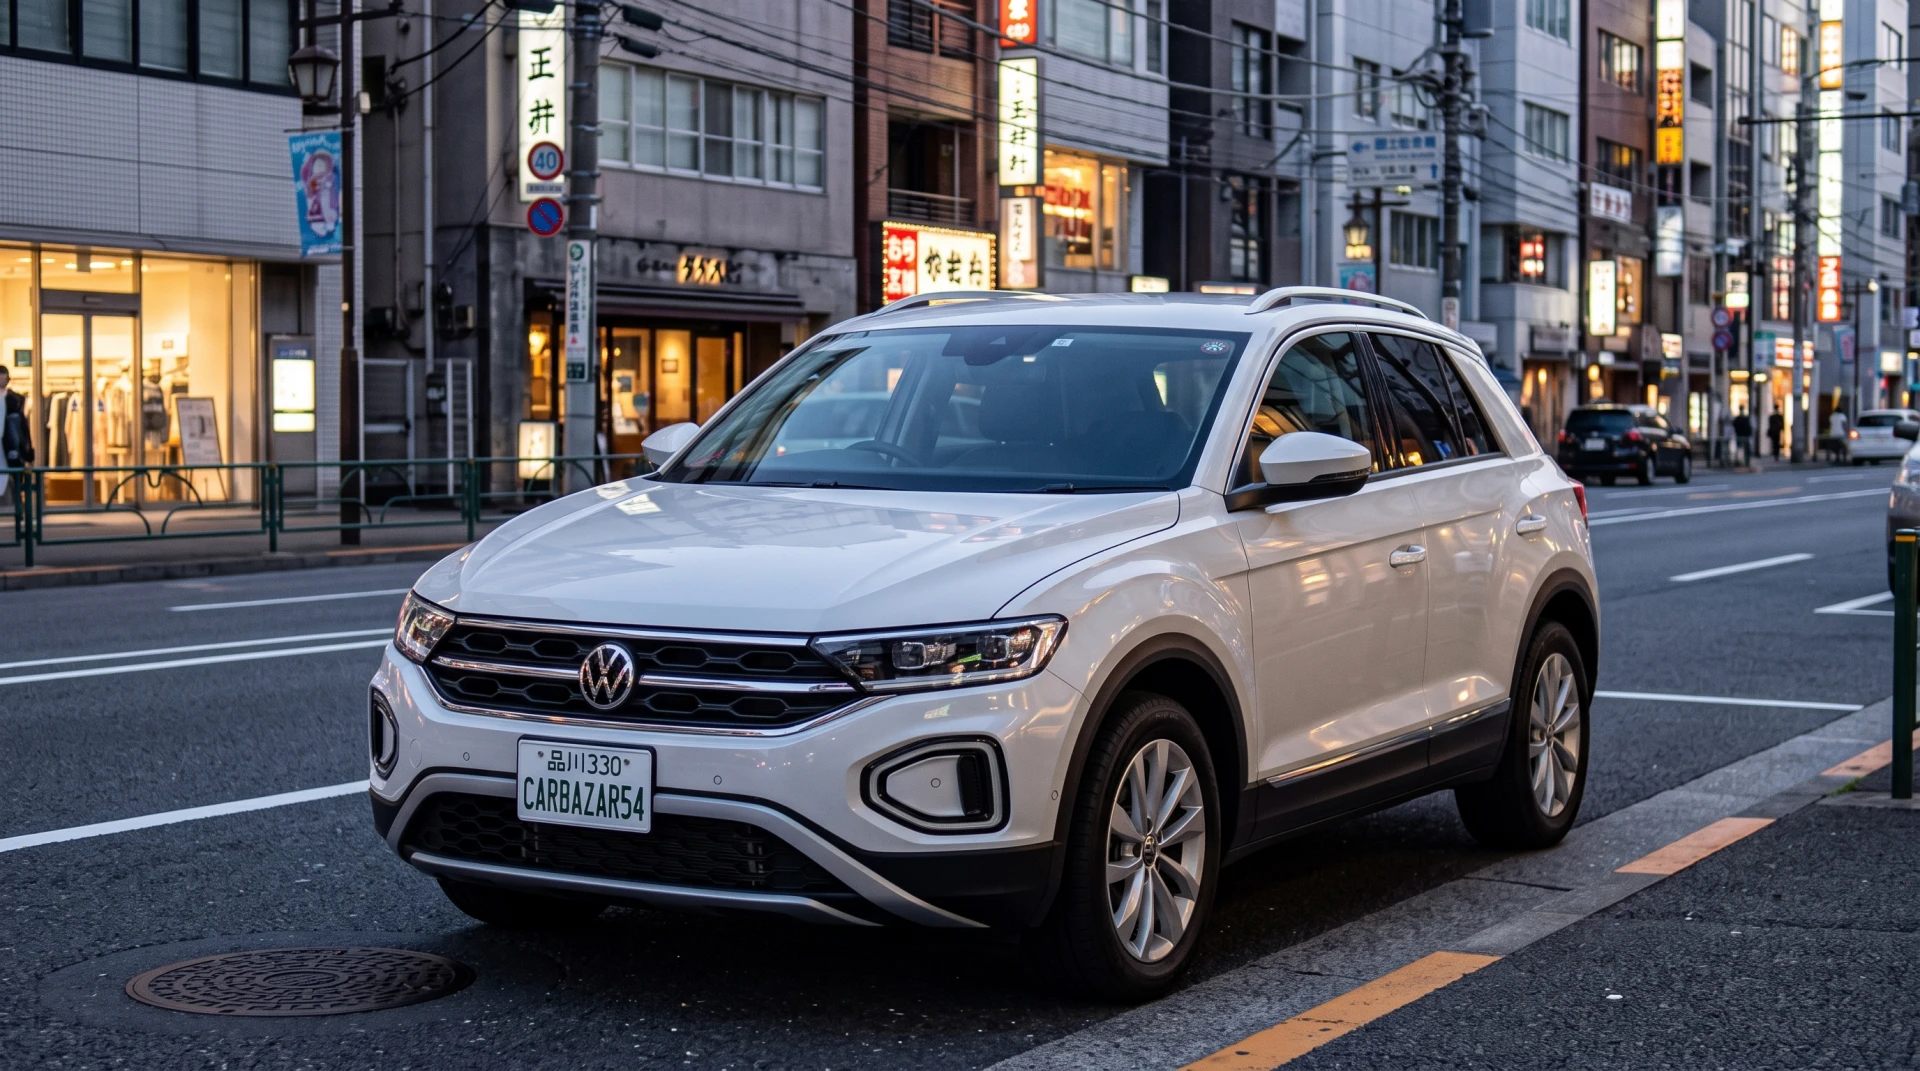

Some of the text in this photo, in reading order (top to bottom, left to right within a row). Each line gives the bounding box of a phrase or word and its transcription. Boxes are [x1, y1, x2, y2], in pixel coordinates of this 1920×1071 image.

[534, 152, 557, 170] 40
[582, 645, 632, 706] VW
[523, 776, 644, 821] CARBAZAR54
